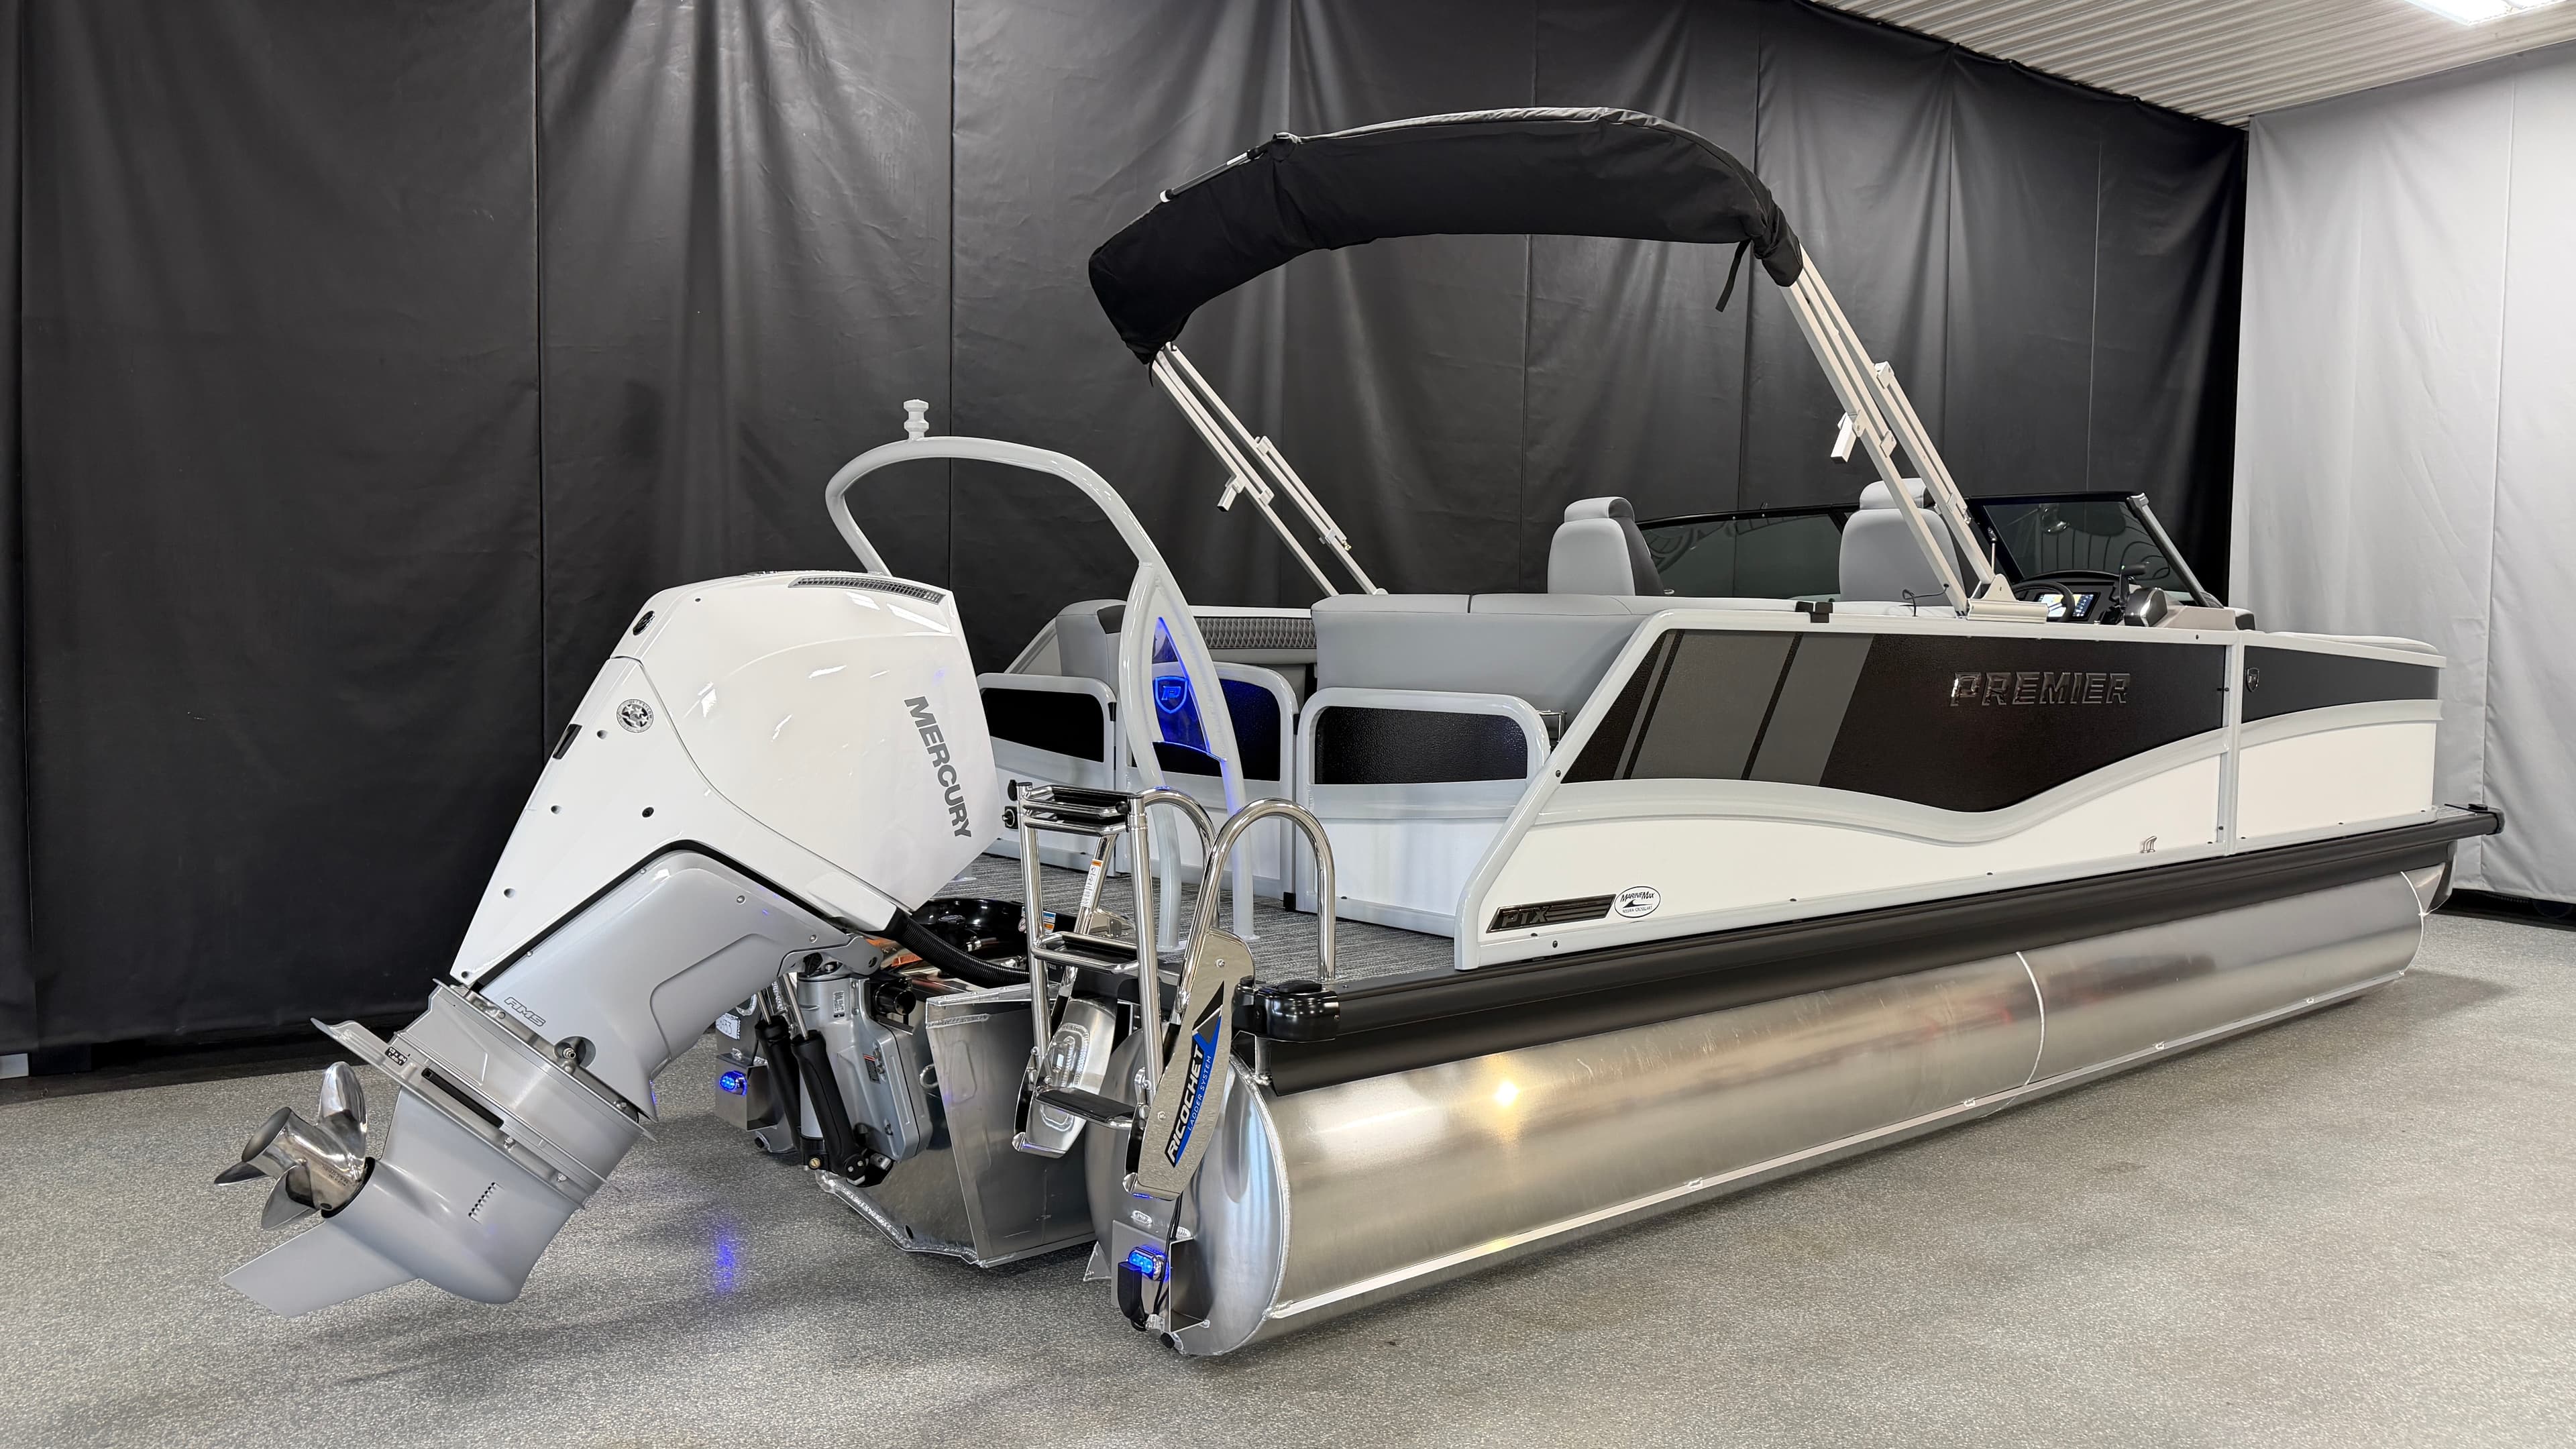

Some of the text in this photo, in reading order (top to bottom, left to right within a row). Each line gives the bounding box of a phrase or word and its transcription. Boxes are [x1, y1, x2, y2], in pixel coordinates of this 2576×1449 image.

[1950, 671, 2131, 706] PREMIER
[904, 696, 972, 838] MERCURY
[1501, 906, 1550, 928] PTX
[504, 996, 547, 1027] AMS
[1167, 1044, 1204, 1165] RICOCHET
[1187, 1055, 1212, 1132] LADDER SYSTEM
